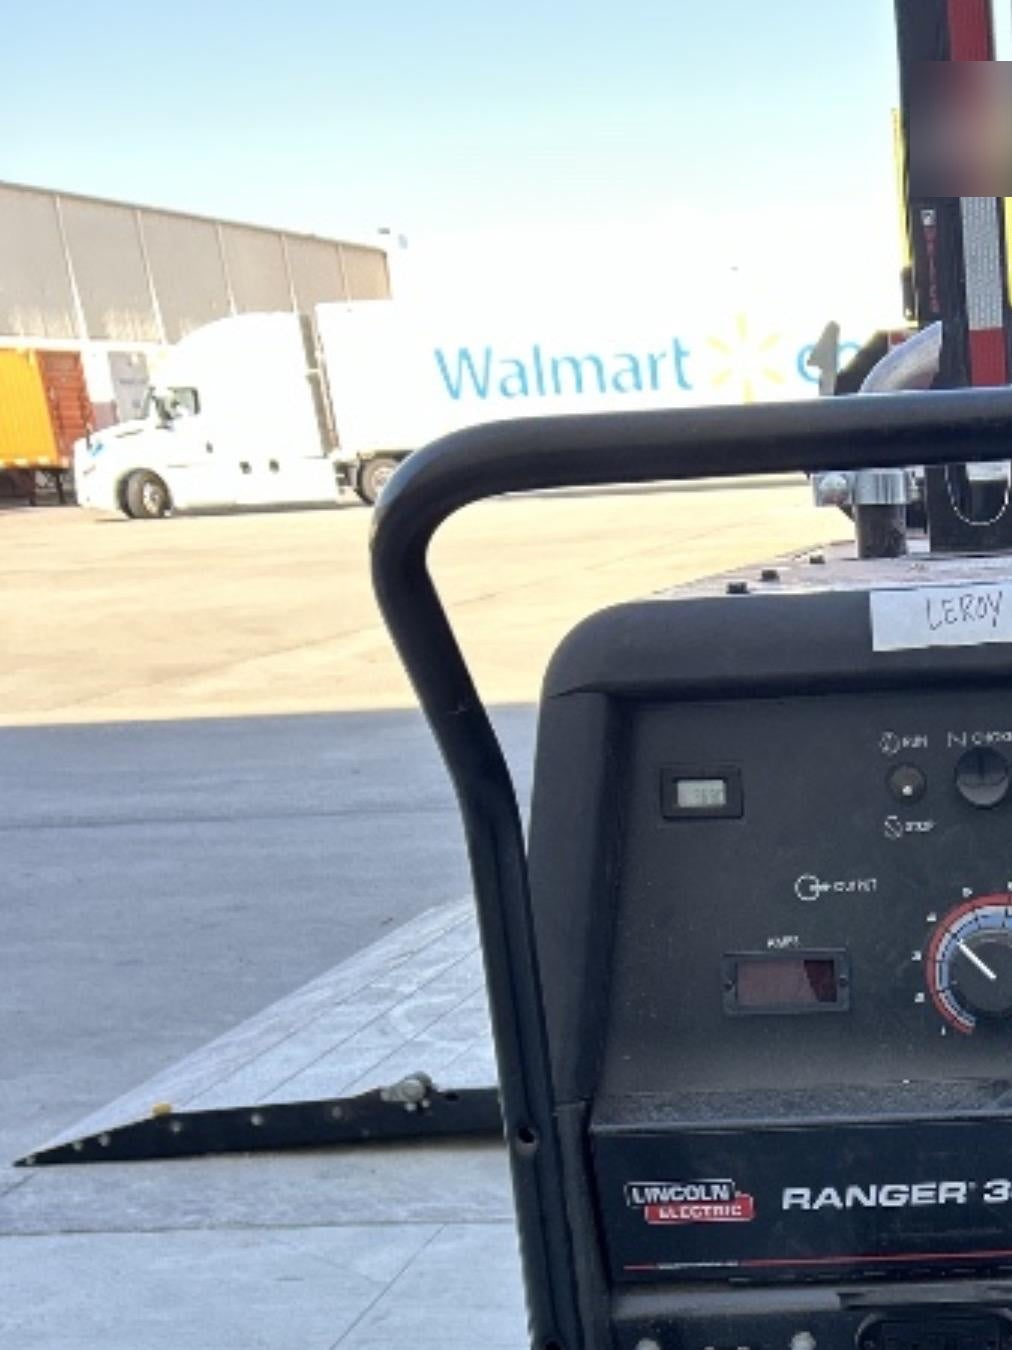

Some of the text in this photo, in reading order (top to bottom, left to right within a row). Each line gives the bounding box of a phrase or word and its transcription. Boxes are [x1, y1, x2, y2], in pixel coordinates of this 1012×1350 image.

[434, 337, 693, 400] Walmart
[926, 591, 1002, 630] LEROY
[631, 1184, 730, 1204] LINCOLN
[782, 1181, 967, 1210] RANGER
[658, 1204, 743, 1220] ELECTRIC
